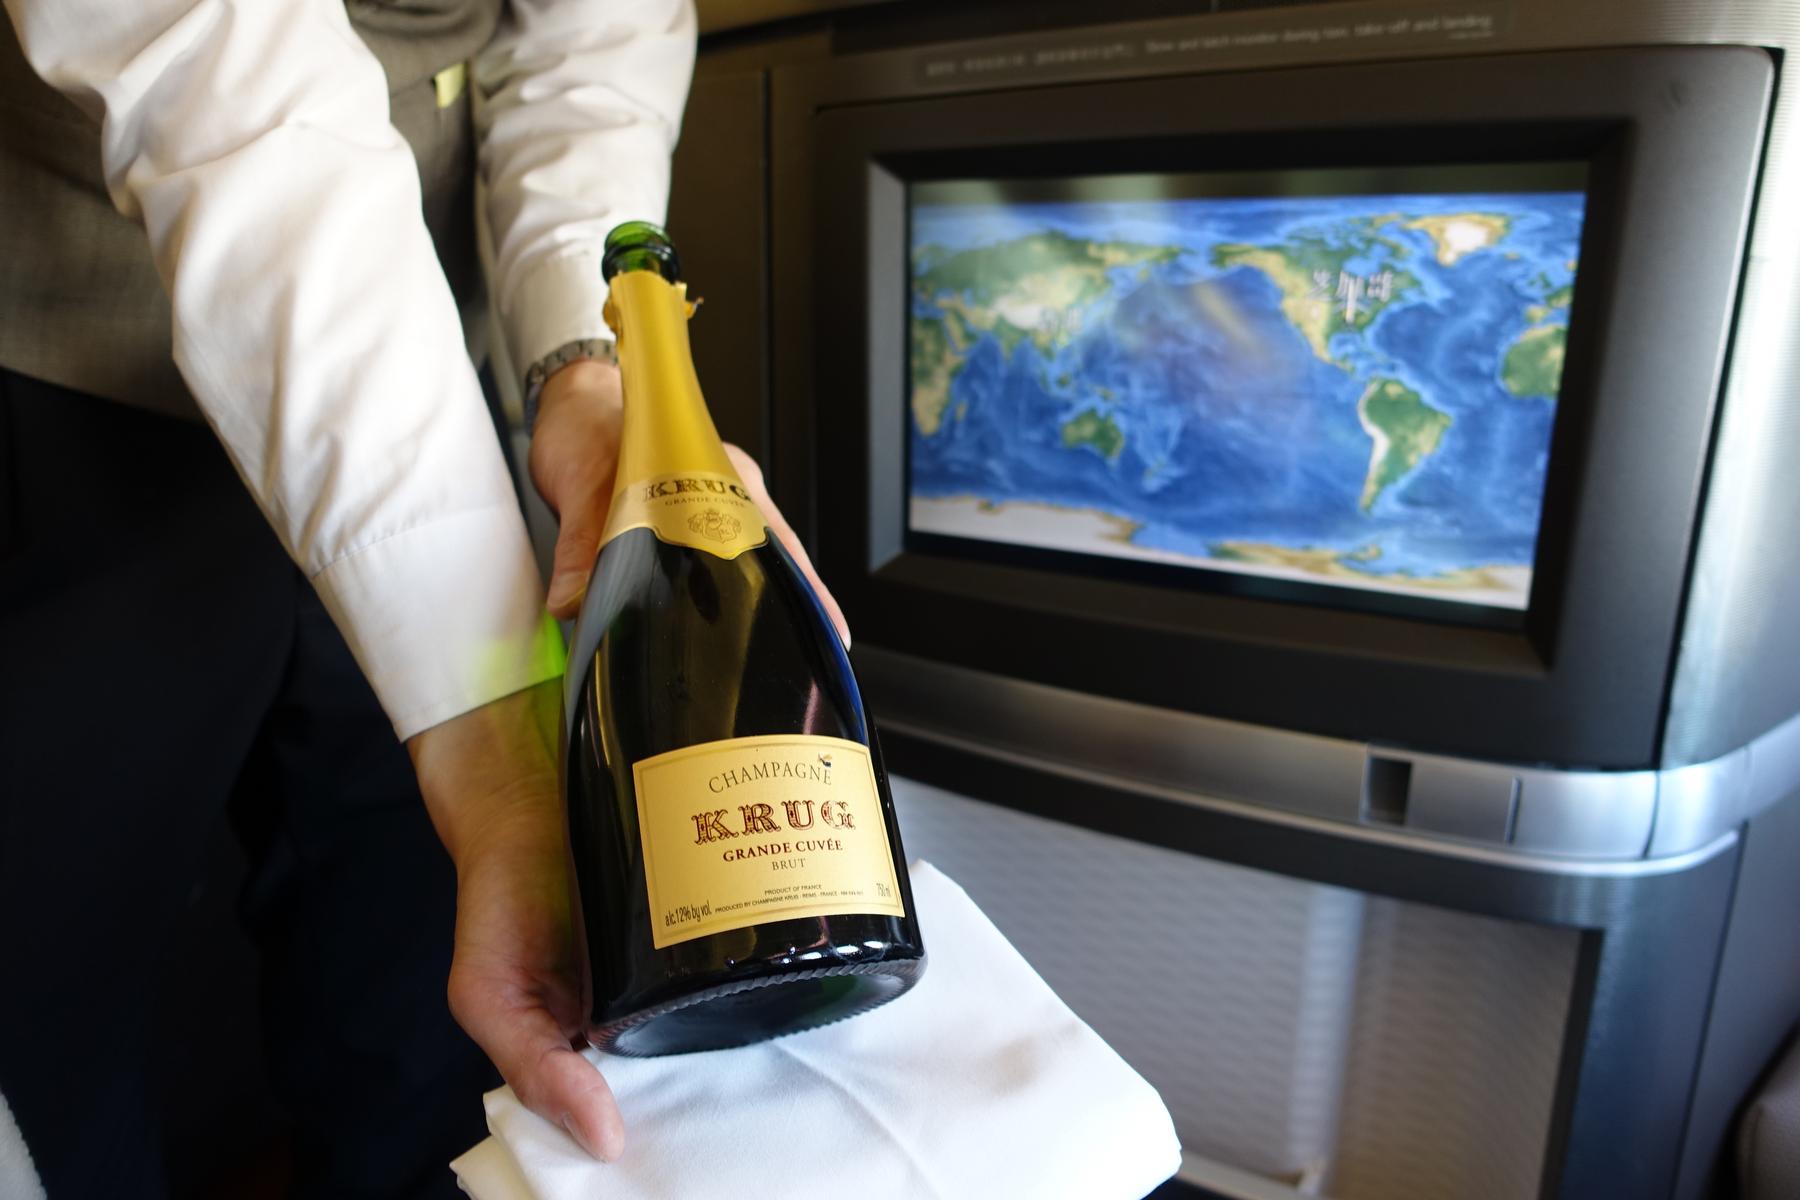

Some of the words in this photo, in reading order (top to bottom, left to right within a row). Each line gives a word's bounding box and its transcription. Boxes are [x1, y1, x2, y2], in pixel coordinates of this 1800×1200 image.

[643, 478, 752, 503] KRUG
[708, 761, 832, 794] CHAMPAGNE
[690, 799, 857, 846] KRUG
[722, 842, 791, 862] GRANDE
[795, 838, 844, 851] CUVÉE
[771, 858, 806, 871] BRUT
[764, 886, 791, 896] PRODUCT
[793, 885, 800, 893] OF
[715, 902, 743, 913] PRODUCED
